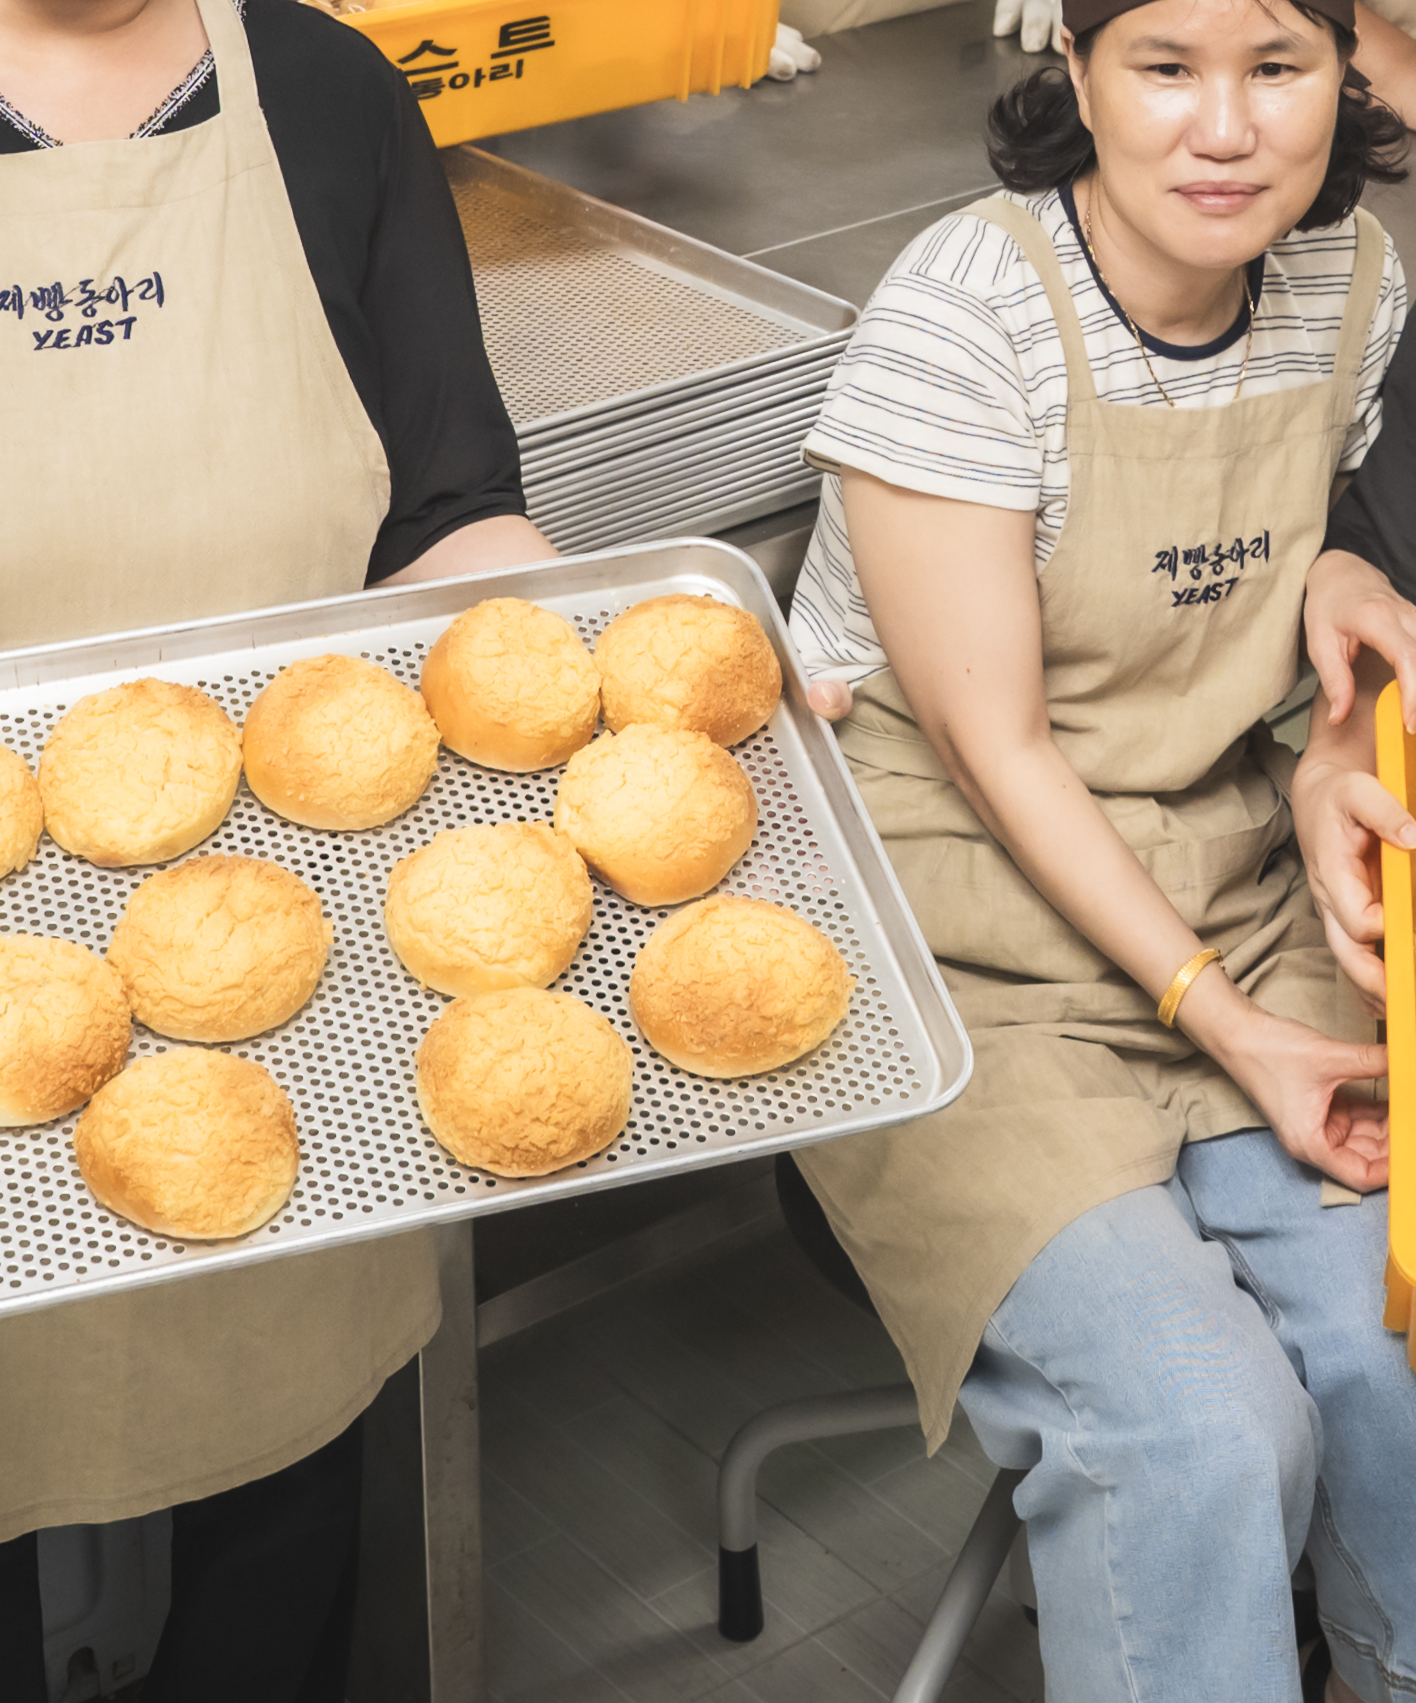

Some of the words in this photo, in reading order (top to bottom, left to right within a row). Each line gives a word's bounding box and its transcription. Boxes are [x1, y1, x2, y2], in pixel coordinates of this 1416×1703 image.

[32, 316, 137, 351] YEAST
[1151, 528, 1270, 581] 제빵동아리
[1171, 577, 1239, 607] YEAST
